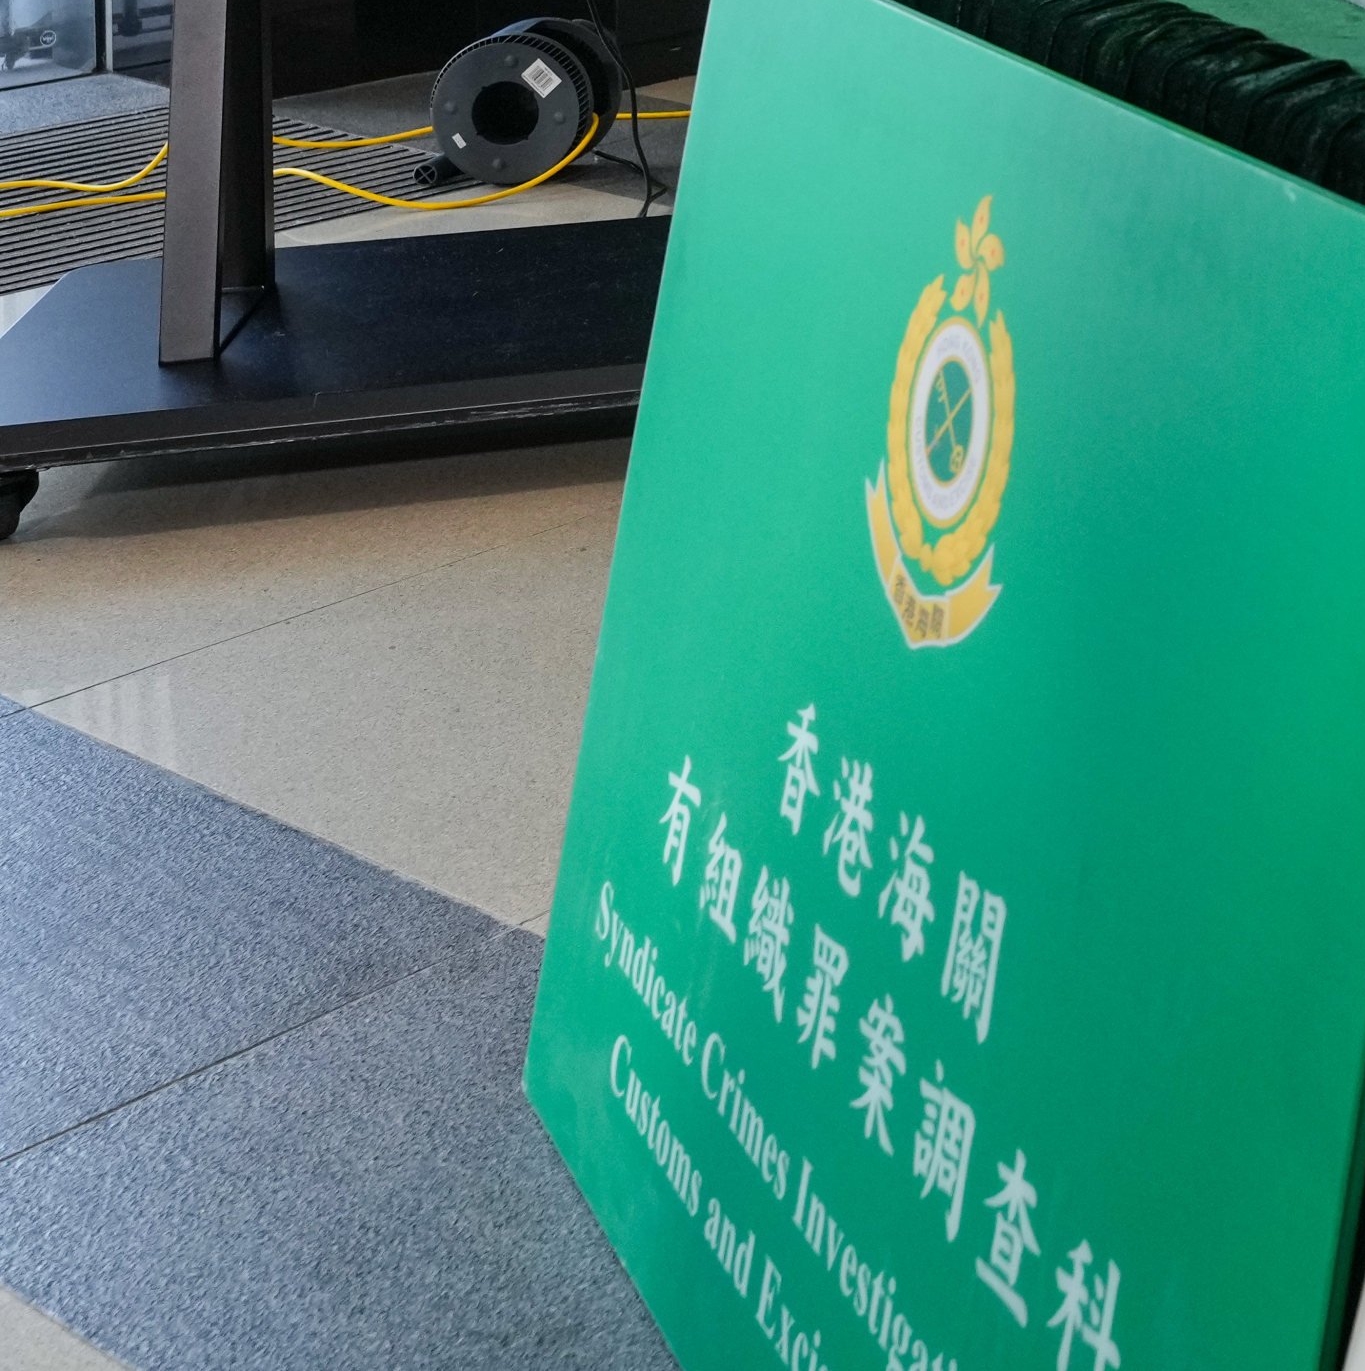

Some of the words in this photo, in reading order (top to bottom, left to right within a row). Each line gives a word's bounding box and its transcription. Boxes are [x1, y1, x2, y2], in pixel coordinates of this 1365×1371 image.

[777, 702, 1006, 1046] 香港海關
[594, 880, 698, 1068] Syndicate
[699, 1031, 792, 1201] Crimes
[609, 1034, 703, 1218] Customs
[703, 1194, 757, 1299] and
[657, 755, 1123, 1371] 有組織罪案調查科
